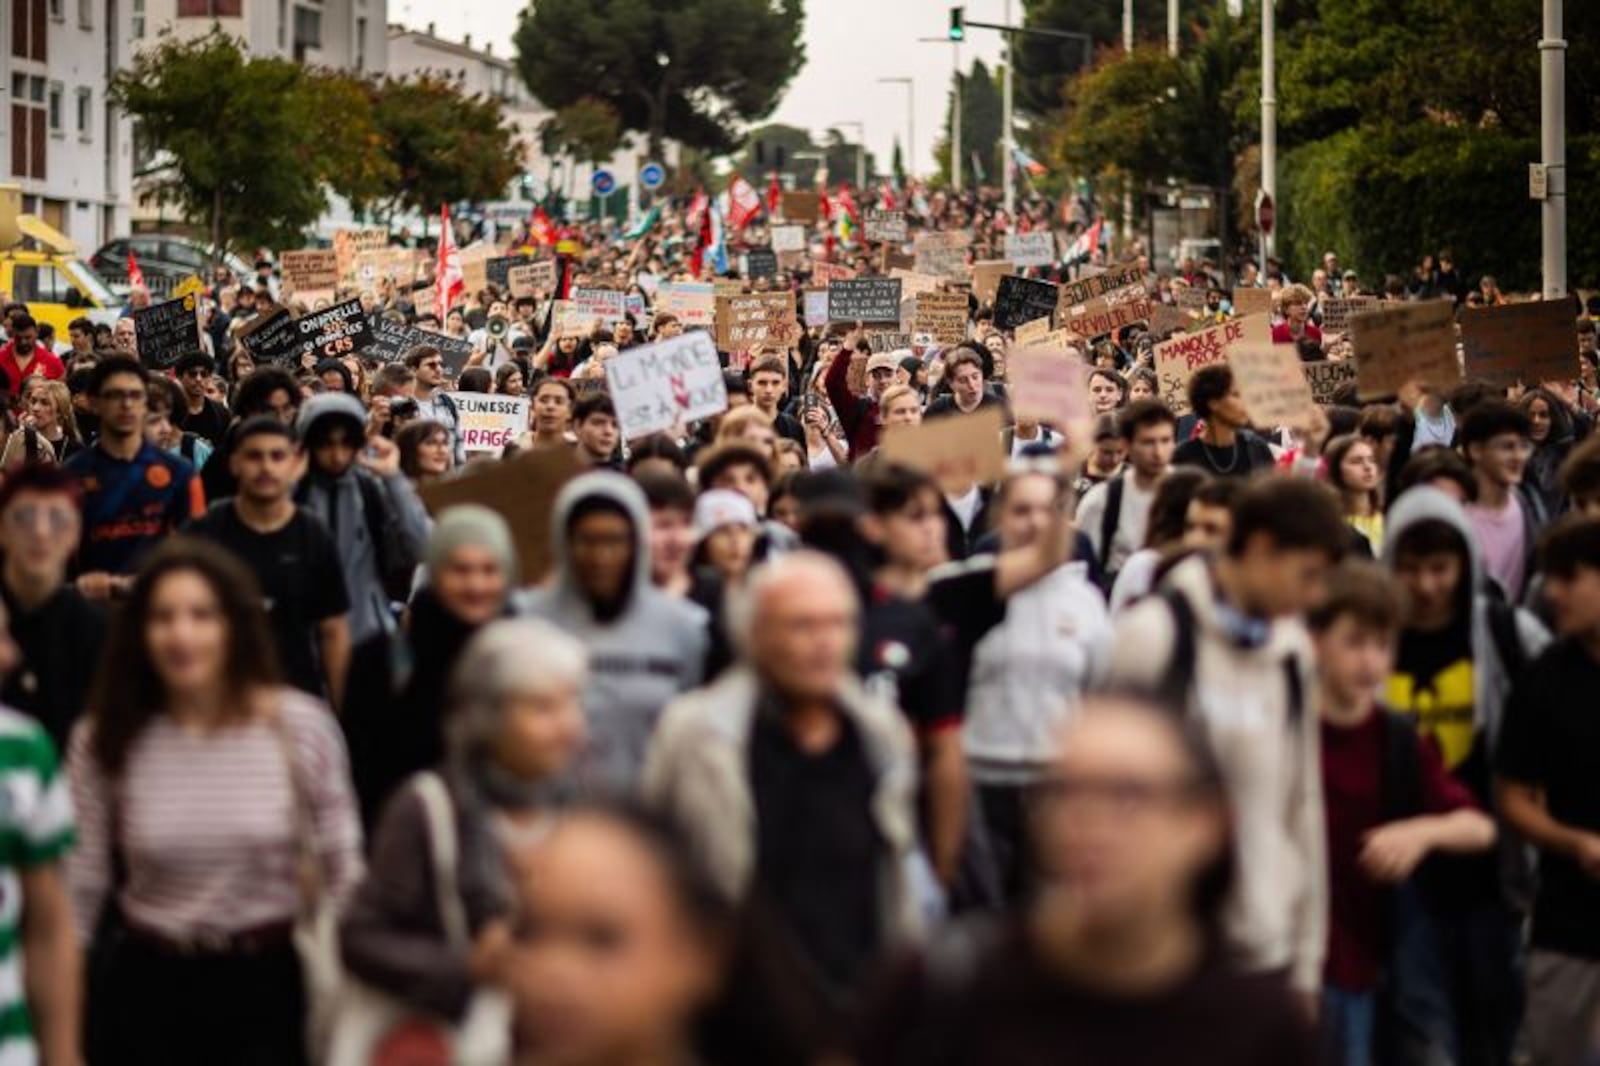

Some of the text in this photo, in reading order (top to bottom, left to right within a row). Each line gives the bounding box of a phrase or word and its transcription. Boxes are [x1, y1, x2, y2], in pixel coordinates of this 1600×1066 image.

[324, 336, 353, 357] CRS
[1160, 321, 1244, 363] MANQUE DE
